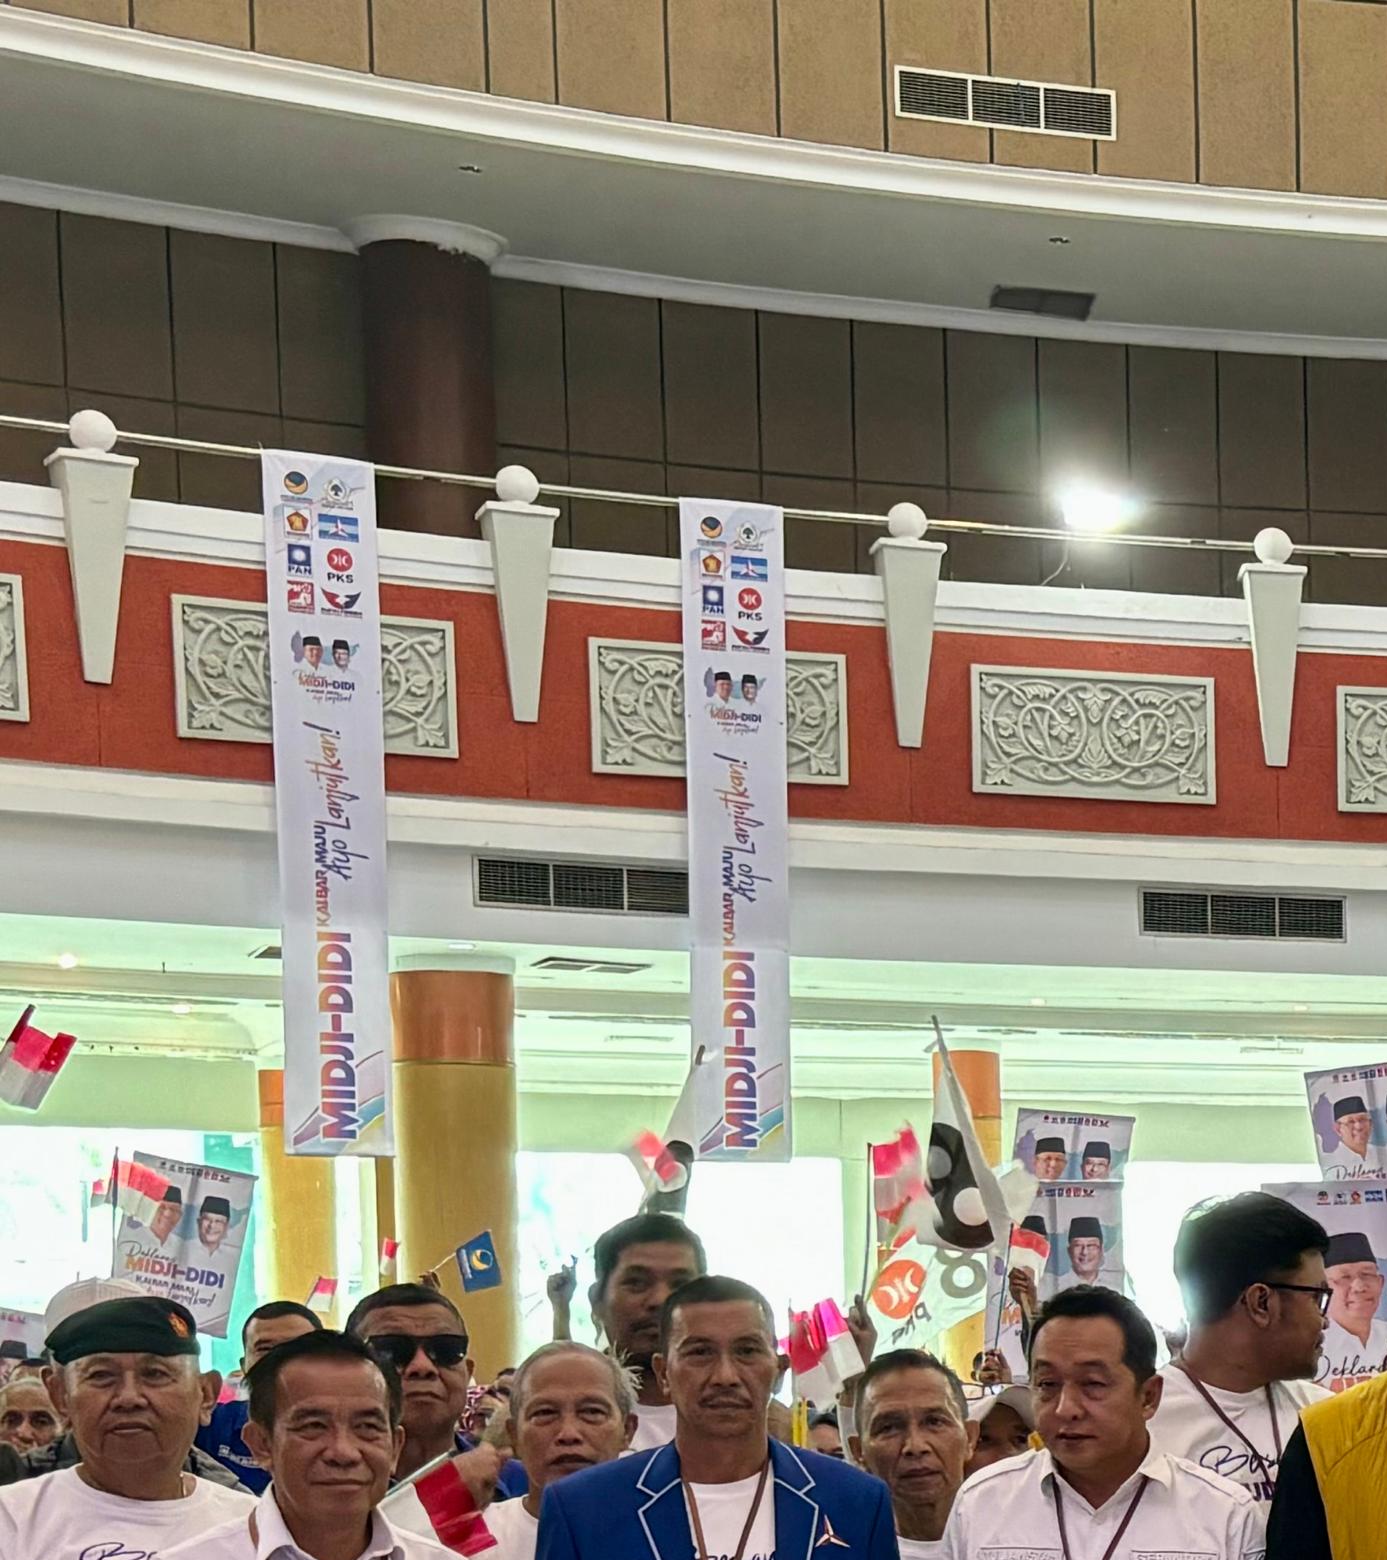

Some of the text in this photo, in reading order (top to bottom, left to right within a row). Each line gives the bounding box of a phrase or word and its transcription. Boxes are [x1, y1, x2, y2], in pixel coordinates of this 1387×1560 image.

[288, 566, 312, 575] PAN
[327, 573, 354, 583] PKS
[738, 611, 763, 621] PKS
[302, 722, 369, 880] Ayo Lanjutkan!
[313, 824, 328, 872] MAJU
[713, 752, 773, 902] Ayo Lanjutkan!
[721, 850, 734, 893] MAJU
[317, 932, 357, 1139] MIDJI-DIDI
[723, 952, 758, 1148] MIDJI-DIDI
[126, 1256, 225, 1288] MIDJI-DIDI
